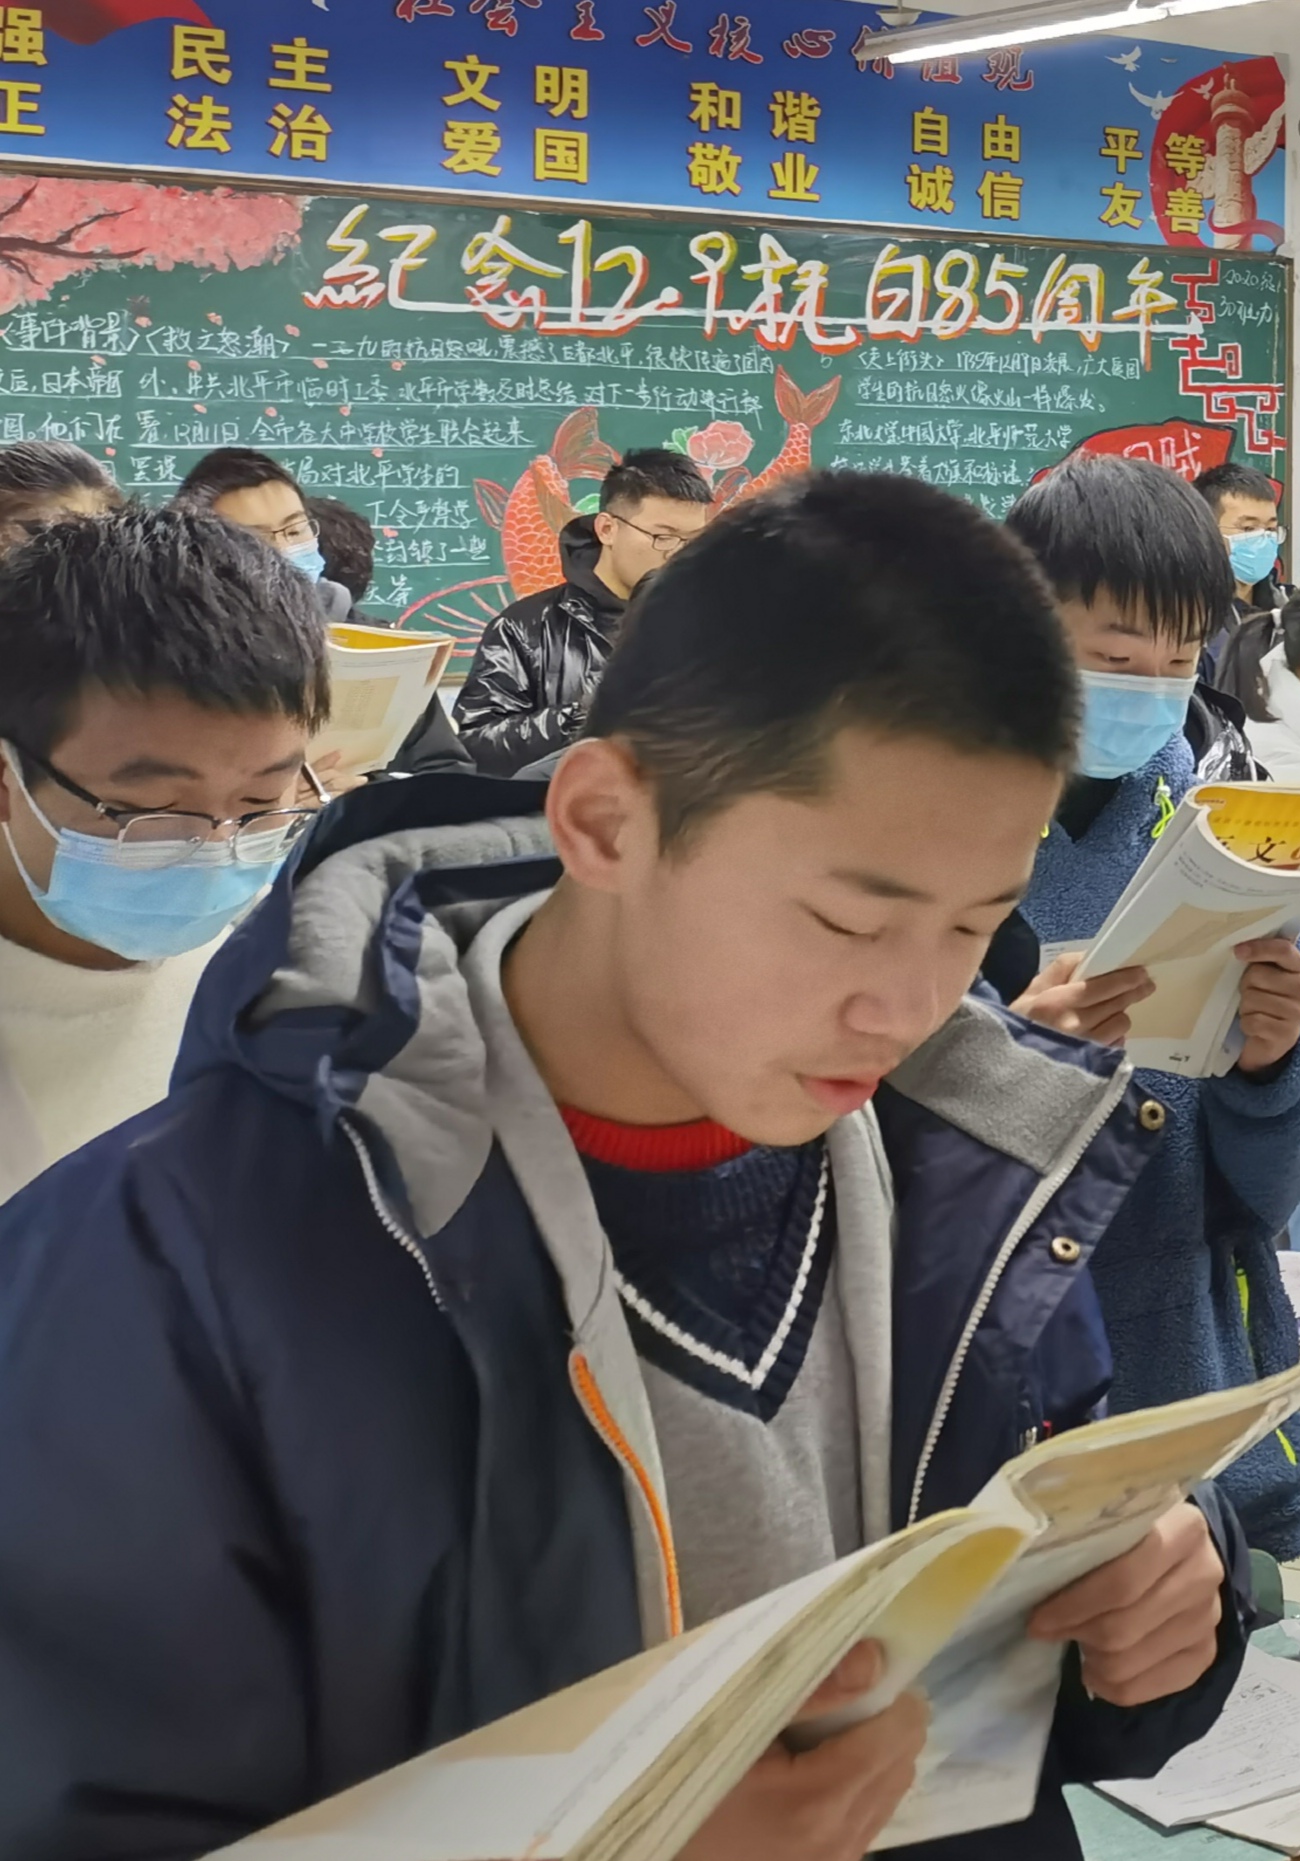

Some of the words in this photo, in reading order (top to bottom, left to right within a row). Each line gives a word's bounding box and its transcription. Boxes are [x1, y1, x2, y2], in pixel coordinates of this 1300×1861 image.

[166, 94, 333, 162] 法治
[441, 120, 589, 185] 爱国
[687, 143, 821, 203] 敬业
[907, 164, 1023, 221] 诚信
[1100, 181, 1206, 235] 友善
[170, 24, 333, 92] 民主
[442, 54, 589, 119] 文明
[689, 82, 822, 144] 和谐
[910, 106, 1022, 163] 自由
[1100, 126, 1206, 179] 平等
